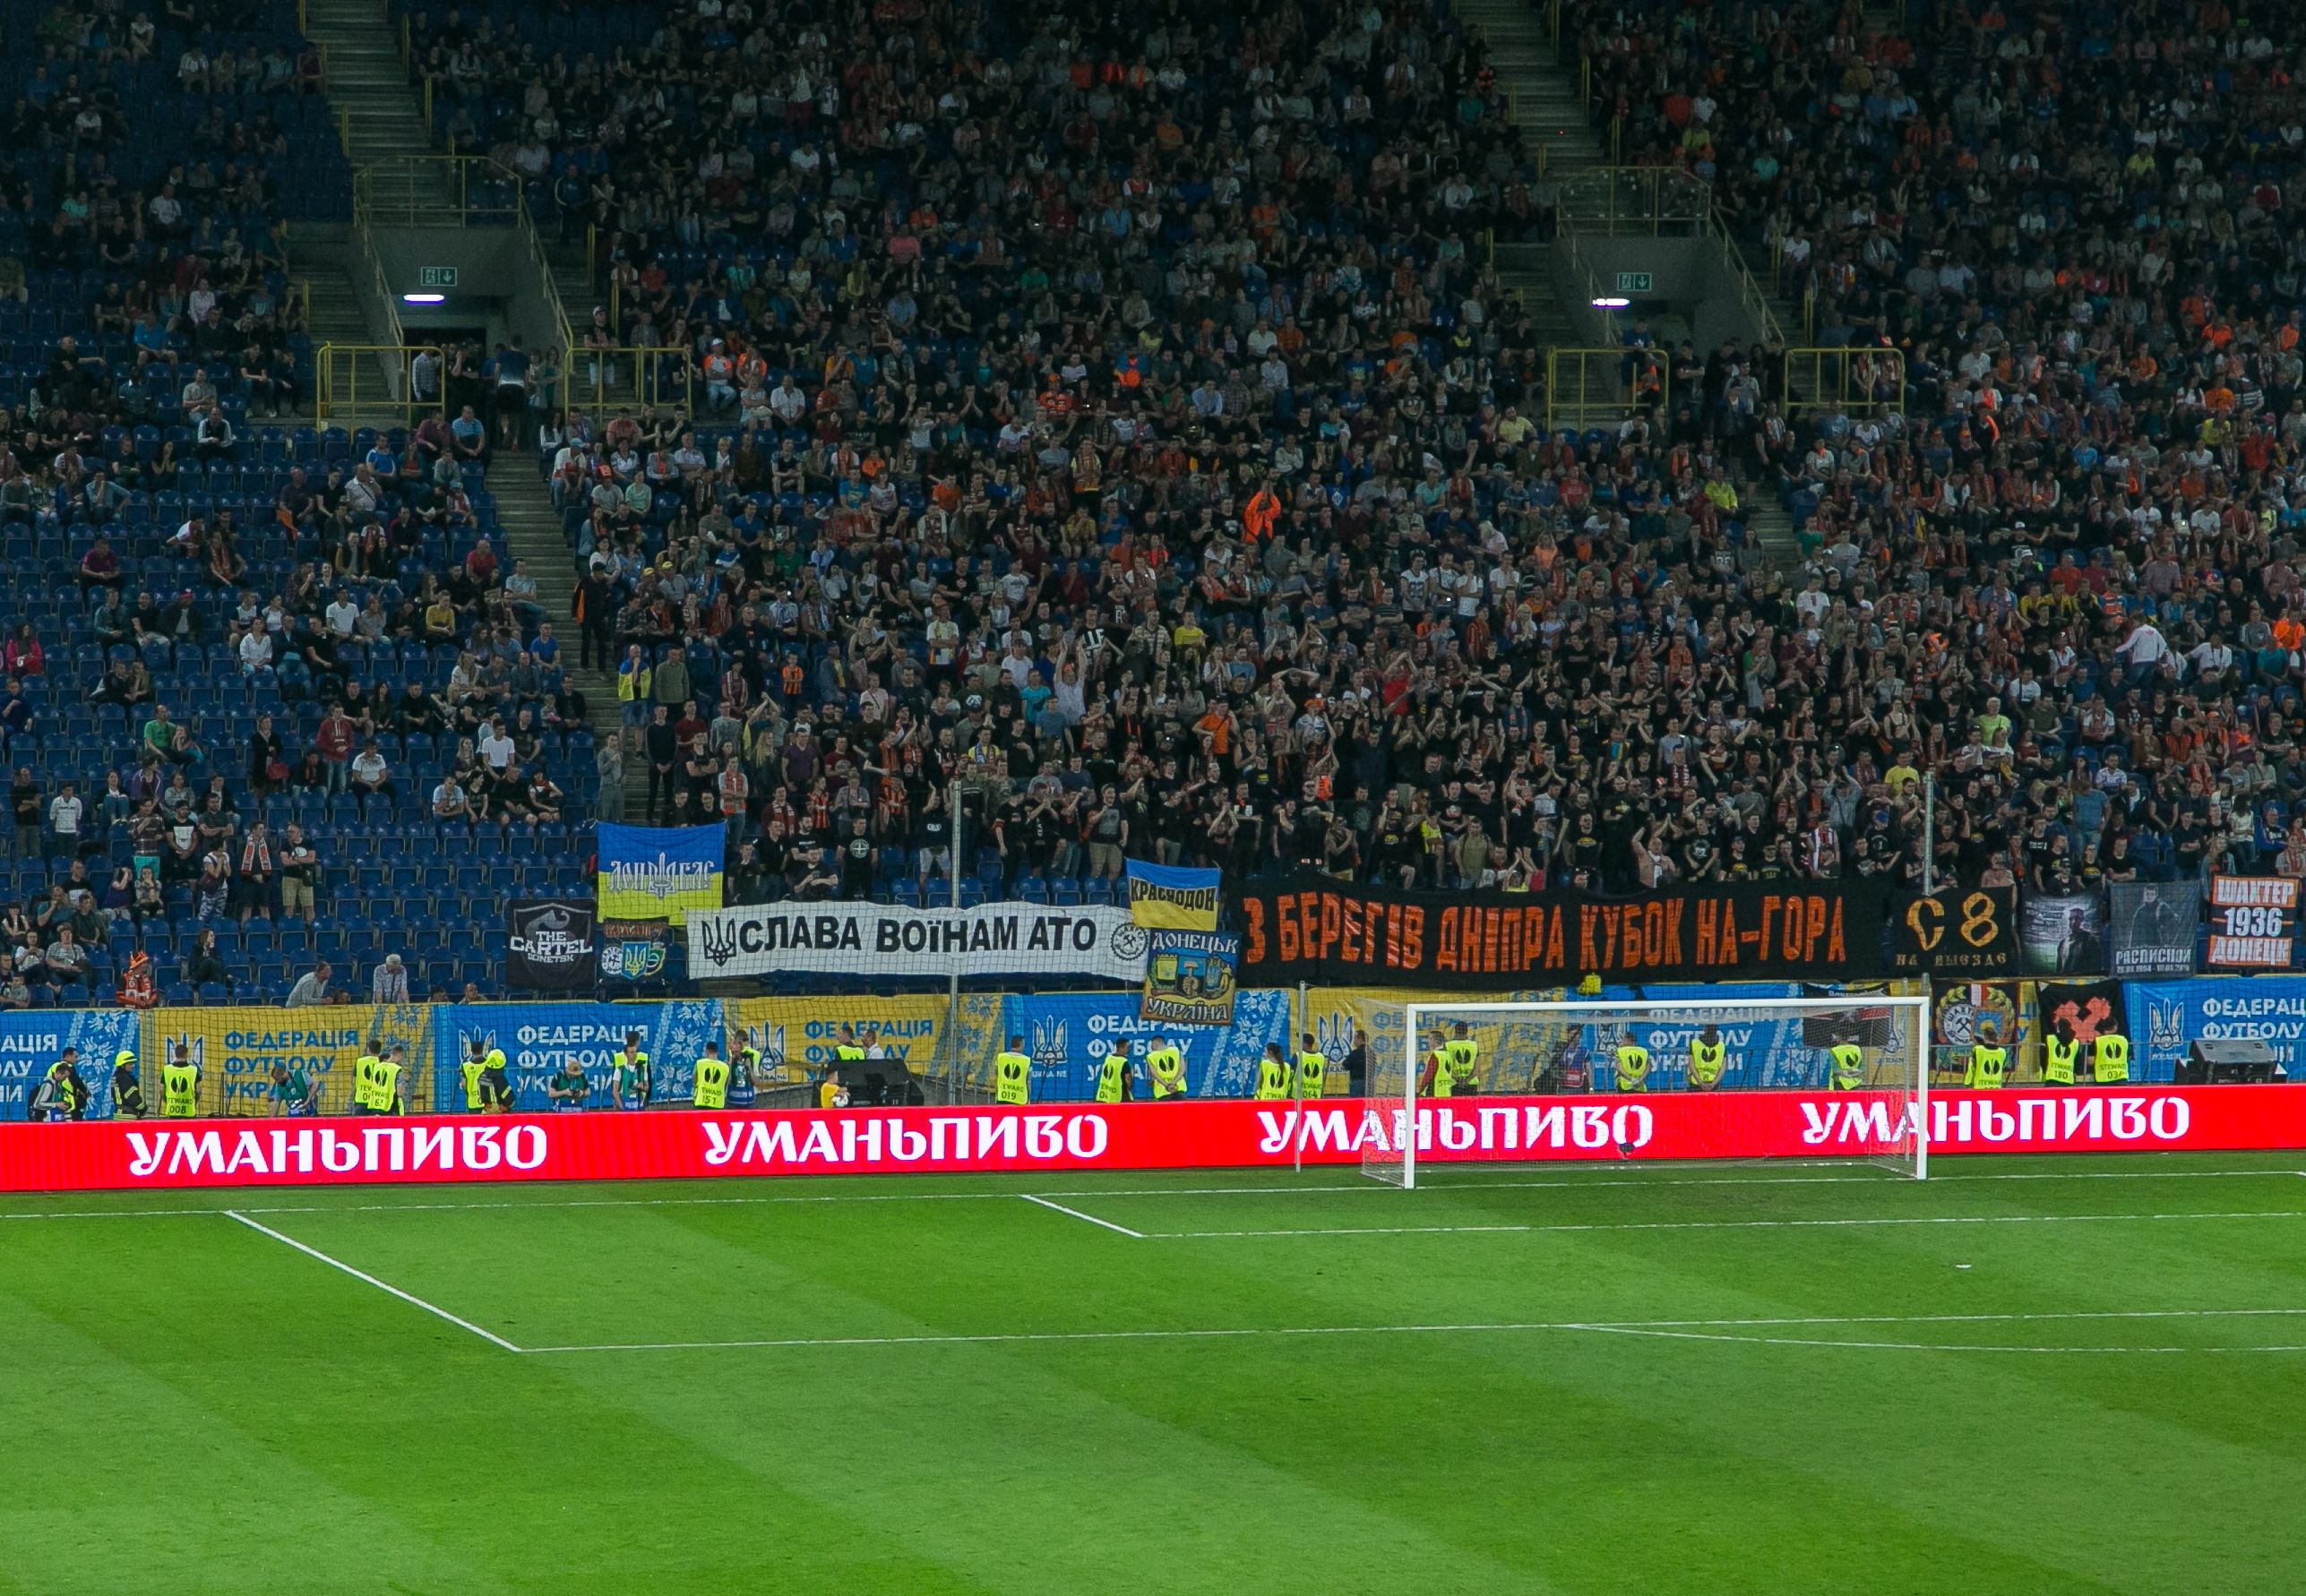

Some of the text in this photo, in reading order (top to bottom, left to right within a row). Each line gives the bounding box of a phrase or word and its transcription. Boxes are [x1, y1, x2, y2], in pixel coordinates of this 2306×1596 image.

[1130, 877, 1217, 911] КРАСНОДОН
[2217, 880, 2294, 904] ШАХТЕР
[1243, 897, 1266, 965] З
[1277, 892, 1424, 969] БЕРЕГІВ
[1436, 904, 1564, 972] ДНІПРА
[1579, 897, 1683, 970] КУБОК
[2224, 906, 2283, 937] 1936
[510, 936, 593, 956] CARTEL
[536, 931, 567, 942] THE
[739, 915, 862, 953] СЛАВА
[1028, 917, 1097, 952] АТО
[1152, 932, 1239, 954] ДОНЕЦЬК
[527, 952, 574, 964] DONETSK
[2211, 937, 2287, 965] ДОНЕЦК
[1147, 996, 1228, 1020] УКРАЇНА
[224, 1030, 358, 1051] ФЕДЕРАЦІЯ
[517, 1025, 648, 1045] ФЕДЕРАЦЯ
[2202, 1021, 2304, 1040] ФУТБОЛУ
[0, 1034, 57, 1054] АЦІЯ
[1087, 1038, 1192, 1058] ФУБЛУ
[1257, 1106, 1653, 1153] УМАНЬПИВО
[1800, 1096, 2190, 1145] УМАНЬПИВО
[126, 1125, 547, 1177] УМАНЬПИВО
[701, 1114, 1108, 1164] УМАНЬПИВО
